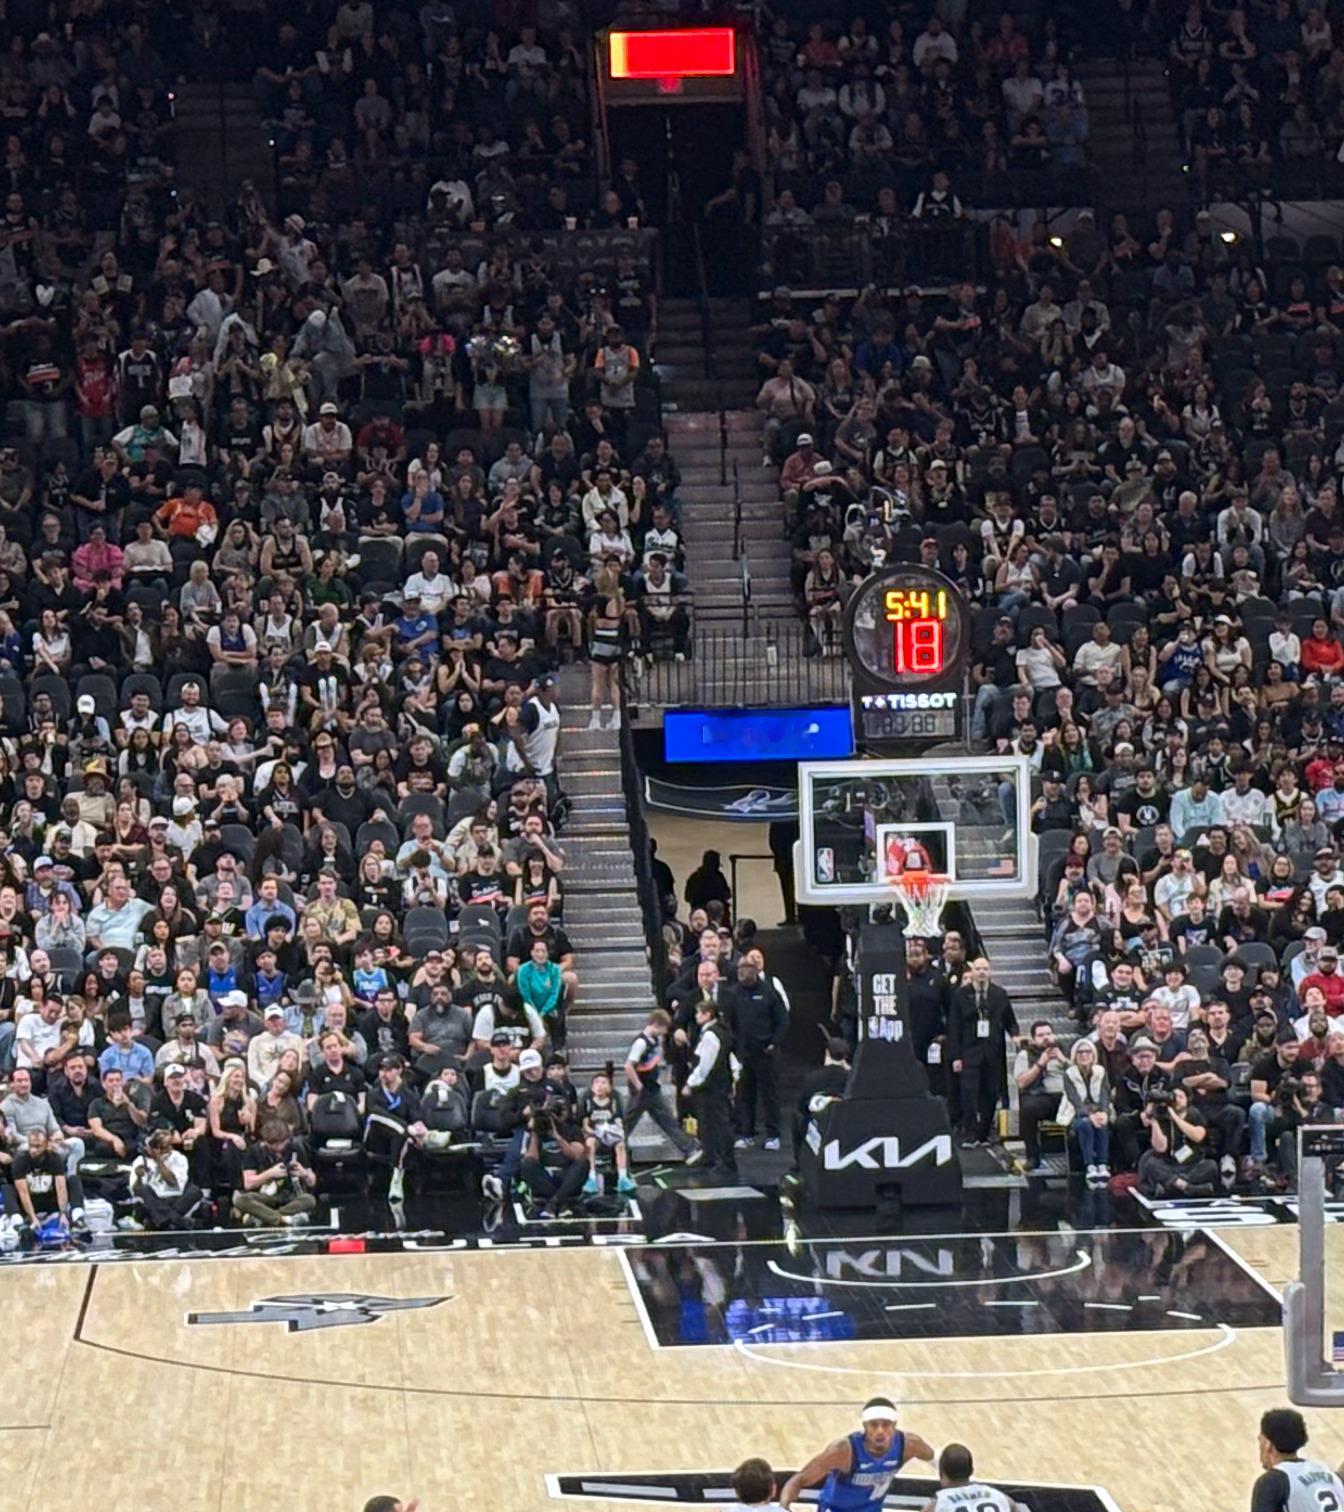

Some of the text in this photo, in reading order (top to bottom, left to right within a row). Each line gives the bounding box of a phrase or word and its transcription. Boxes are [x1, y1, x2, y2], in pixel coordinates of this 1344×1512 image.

[885, 590, 947, 621] 5:41
[895, 620, 943, 673] 18
[887, 692, 958, 709] TISSOT
[873, 995, 898, 1016] THE
